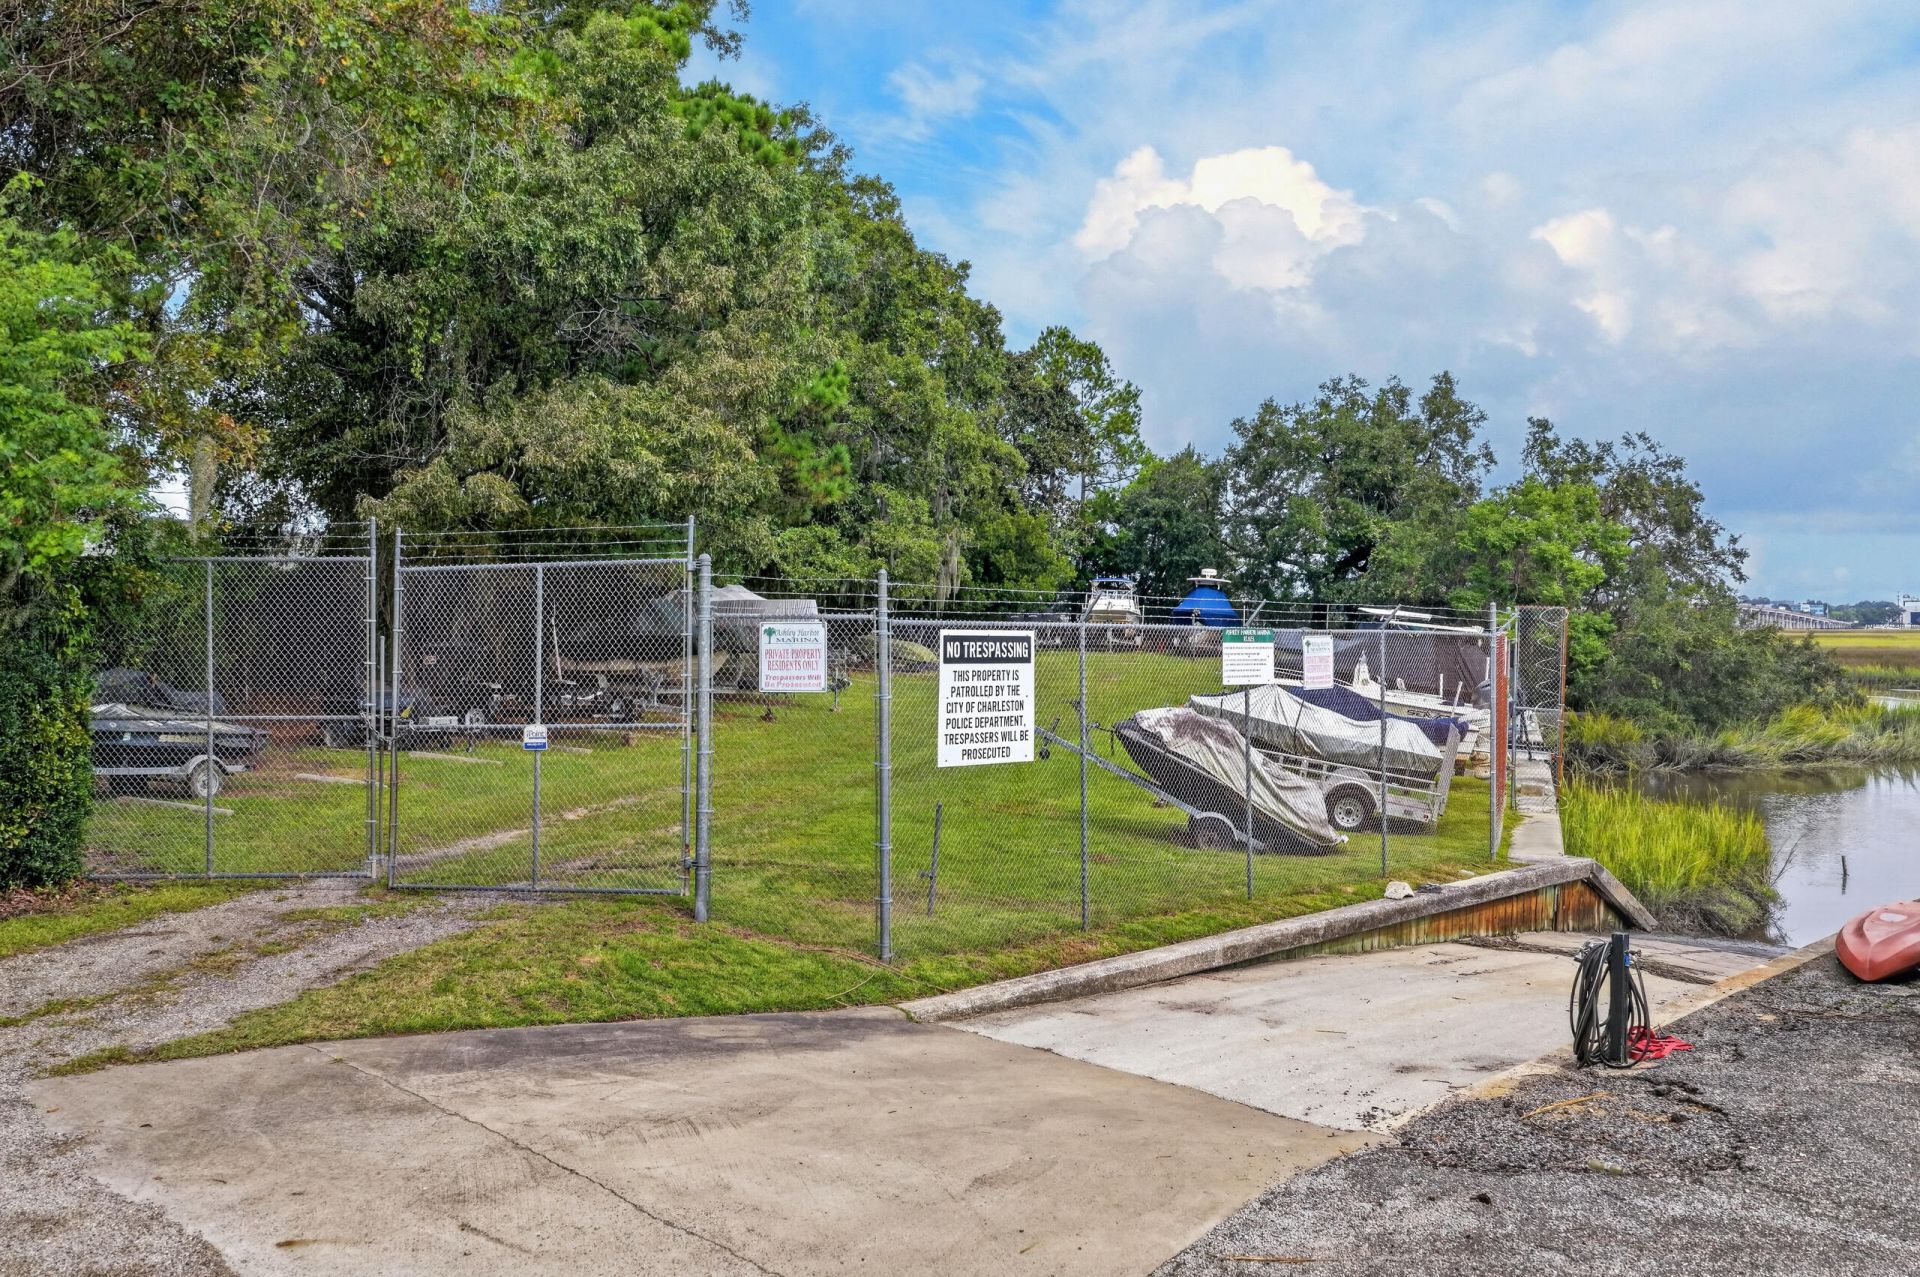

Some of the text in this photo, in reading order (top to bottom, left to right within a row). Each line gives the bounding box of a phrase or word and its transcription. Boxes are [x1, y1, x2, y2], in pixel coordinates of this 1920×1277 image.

[775, 628, 820, 636] Ashley Harbor
[765, 649, 821, 659] PRIVATE PROPERTY
[946, 642, 1029, 658] NO TRESPASSING
[768, 660, 818, 670] RESIDENTS ONLY
[953, 670, 1019, 682] THIS PROPERTY IS
[951, 685, 1020, 698] PATROLLED BY THE
[946, 700, 1024, 713] CITY OF CHARLESTON
[946, 718, 972, 729] POLICE
[944, 730, 1029, 745] TRESPASSERS WILL BE
[962, 746, 1010, 760] PROSECUTED
